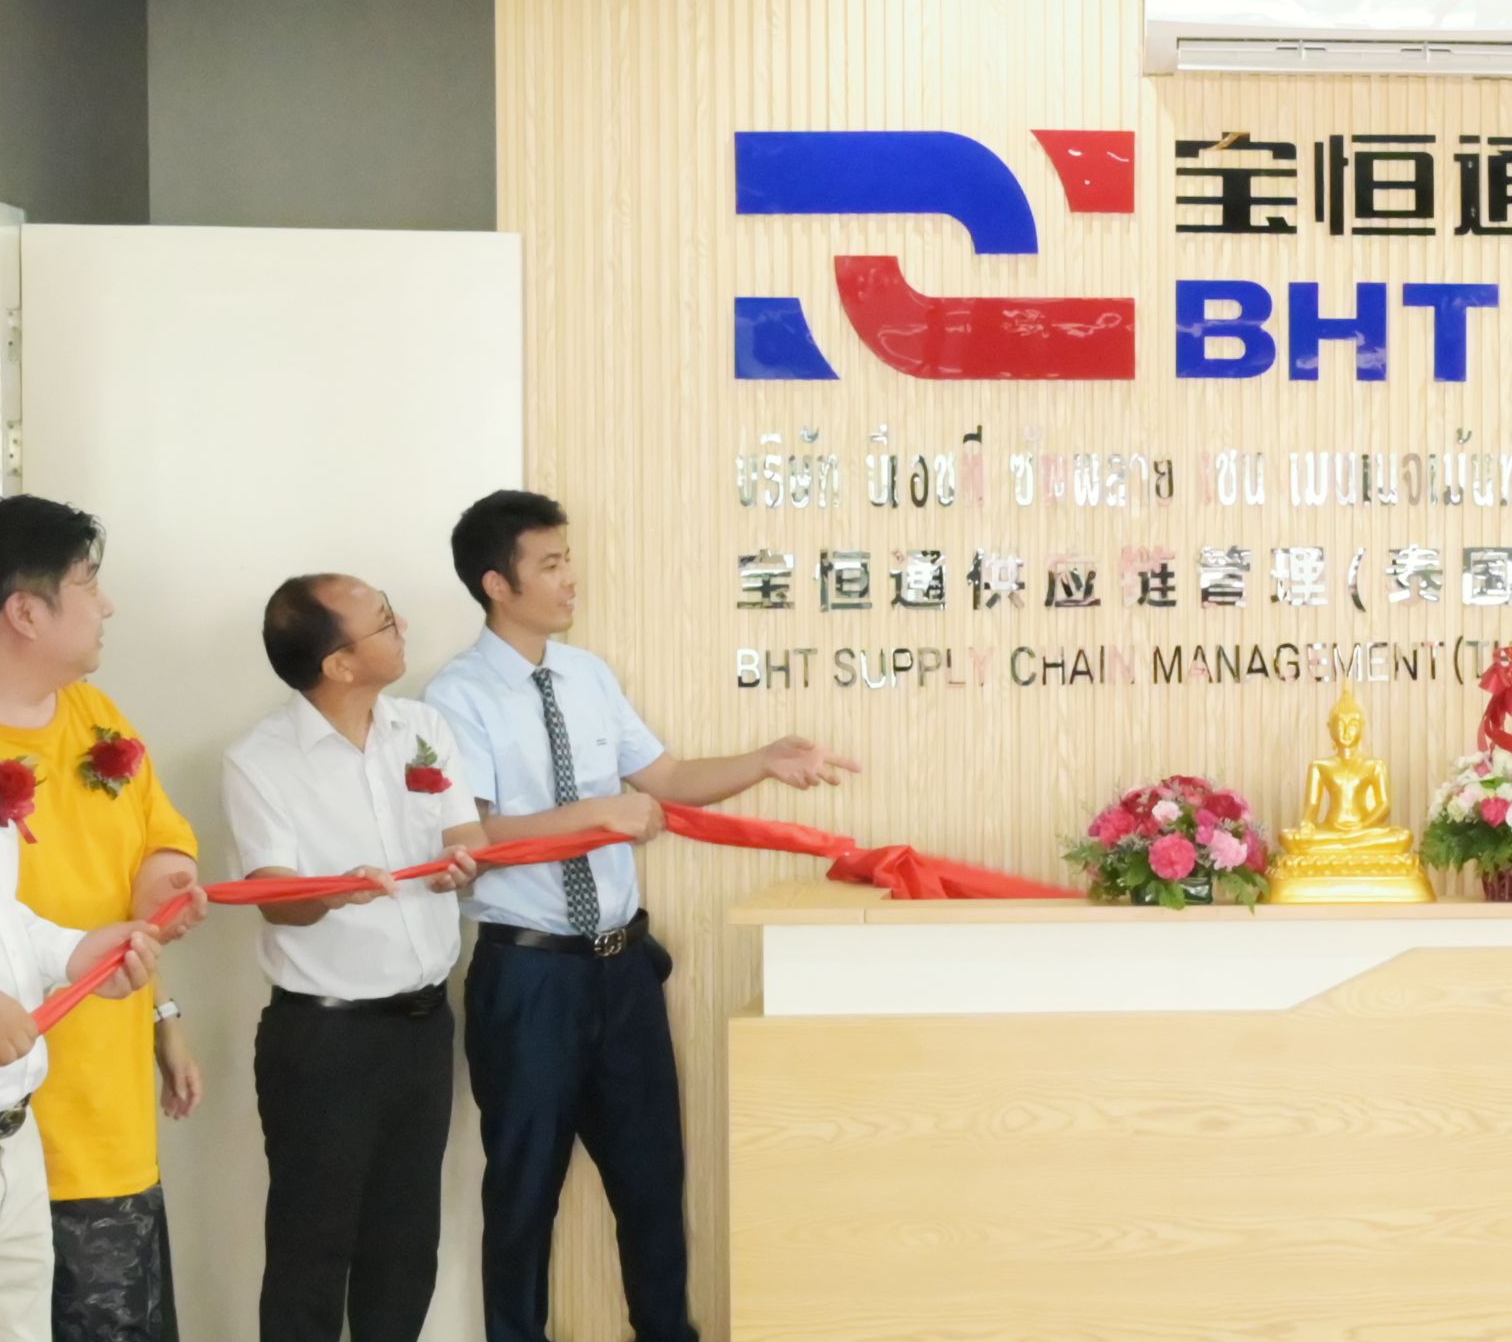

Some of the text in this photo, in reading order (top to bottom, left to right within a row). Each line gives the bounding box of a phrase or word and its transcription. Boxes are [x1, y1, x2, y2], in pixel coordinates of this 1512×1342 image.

[1175, 279, 1499, 382] BHT
[736, 647, 818, 689] BHT
[833, 646, 988, 689] SUPPLY
[1009, 645, 1136, 688] CHAIN
